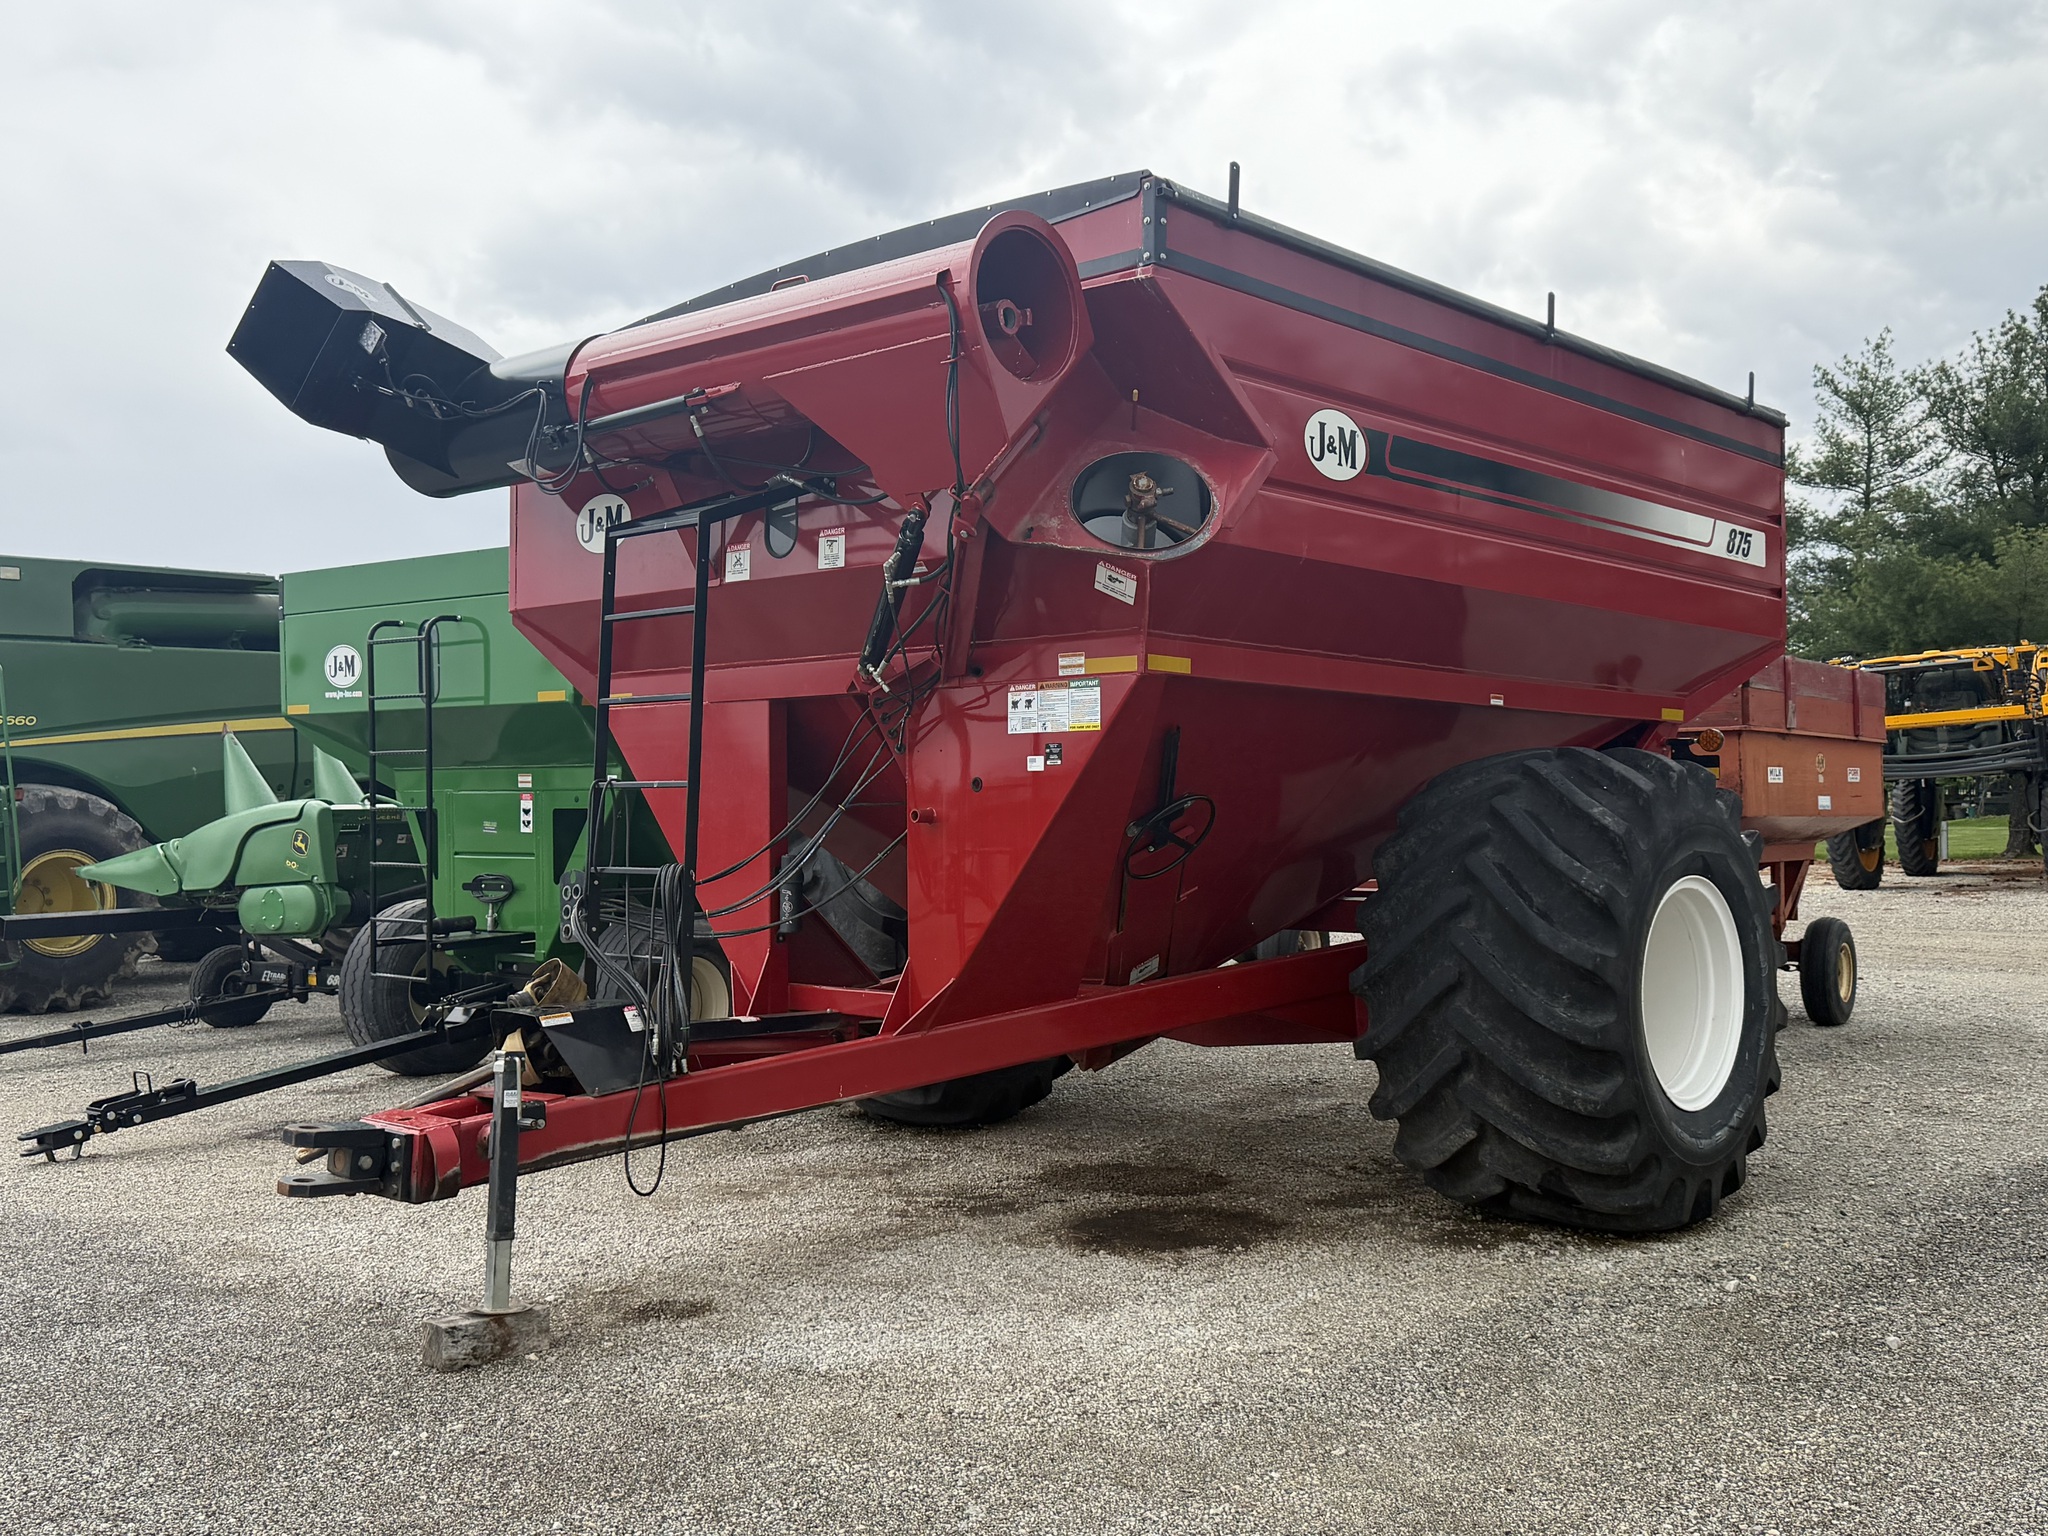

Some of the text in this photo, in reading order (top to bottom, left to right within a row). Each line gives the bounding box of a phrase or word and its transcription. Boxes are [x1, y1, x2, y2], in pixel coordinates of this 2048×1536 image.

[1309, 421, 1357, 470] J&M
[580, 503, 624, 543] J&M
[824, 527, 845, 536] DANGER
[730, 543, 750, 552] DANGER
[1726, 528, 1752, 557] 875
[1105, 562, 1137, 580] DANGER
[328, 655, 355, 678] J&M
[1045, 682, 1067, 690] WARNING
[1070, 680, 1098, 688] IMPORTANT
[0, 715, 37, 726] 660
[326, 974, 340, 986] 68
